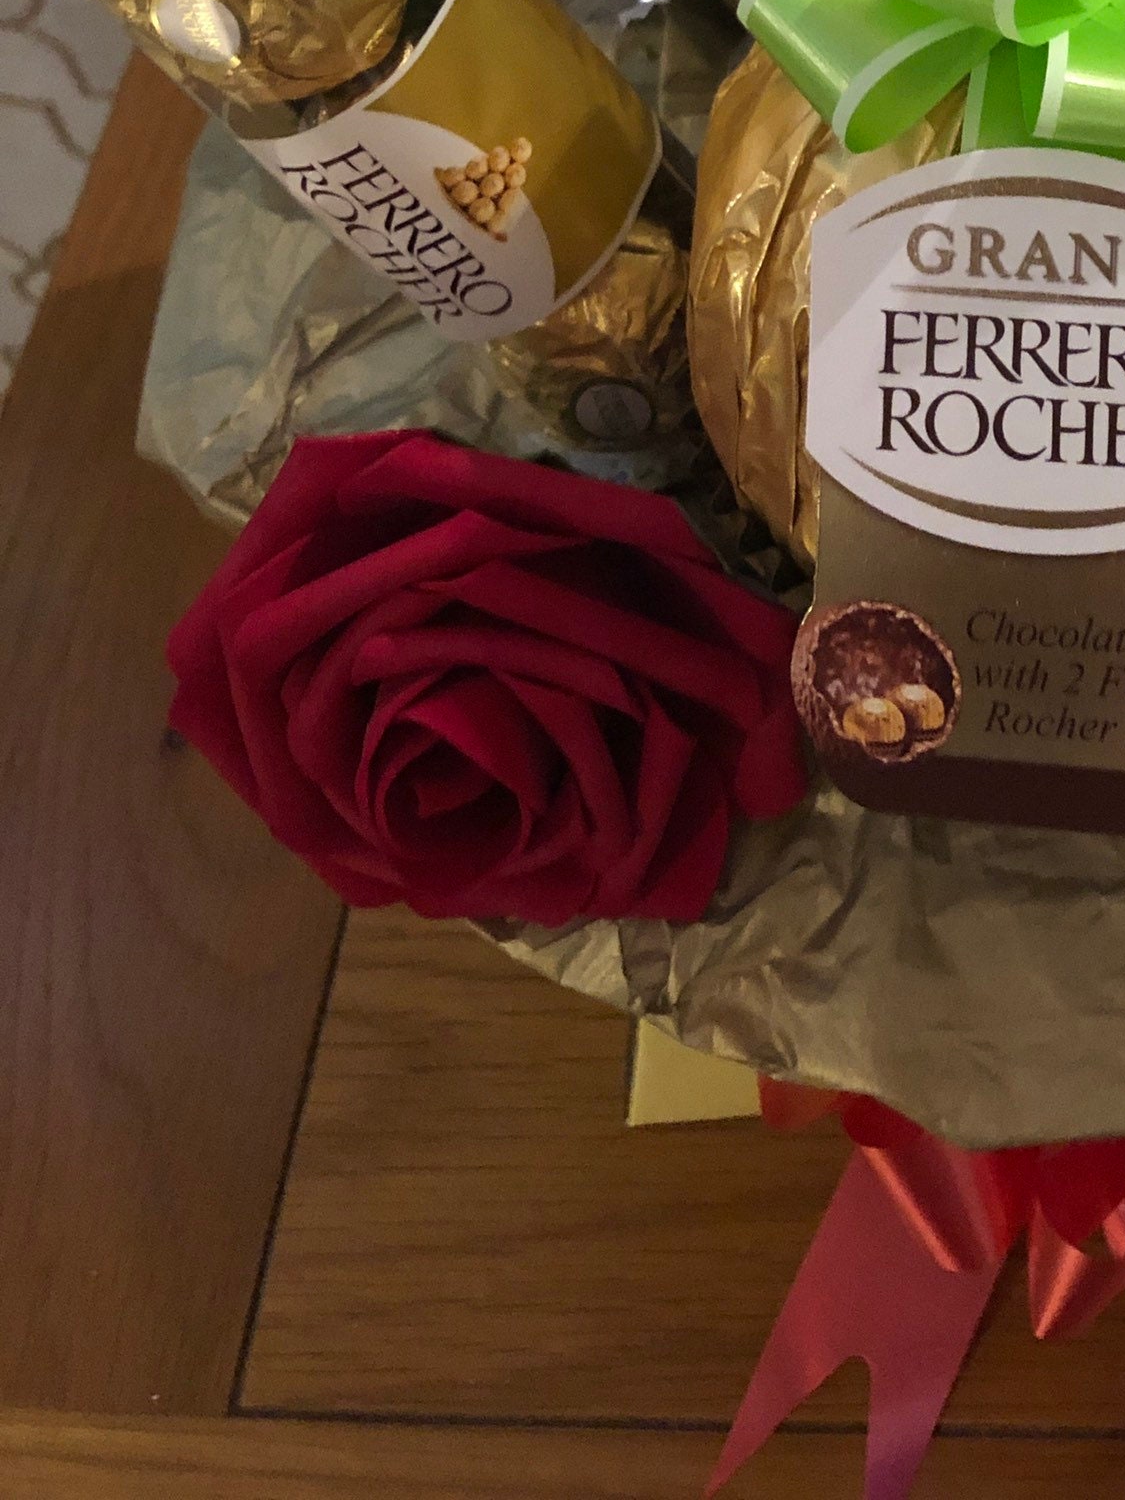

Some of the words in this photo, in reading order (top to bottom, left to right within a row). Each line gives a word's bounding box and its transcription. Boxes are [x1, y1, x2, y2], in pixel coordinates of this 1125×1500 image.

[279, 162, 463, 326] ROCHER
[318, 142, 513, 317] FERRERO
[974, 658, 1050, 693] with
[1062, 661, 1085, 696] 2
[985, 700, 1118, 743] Rocher
